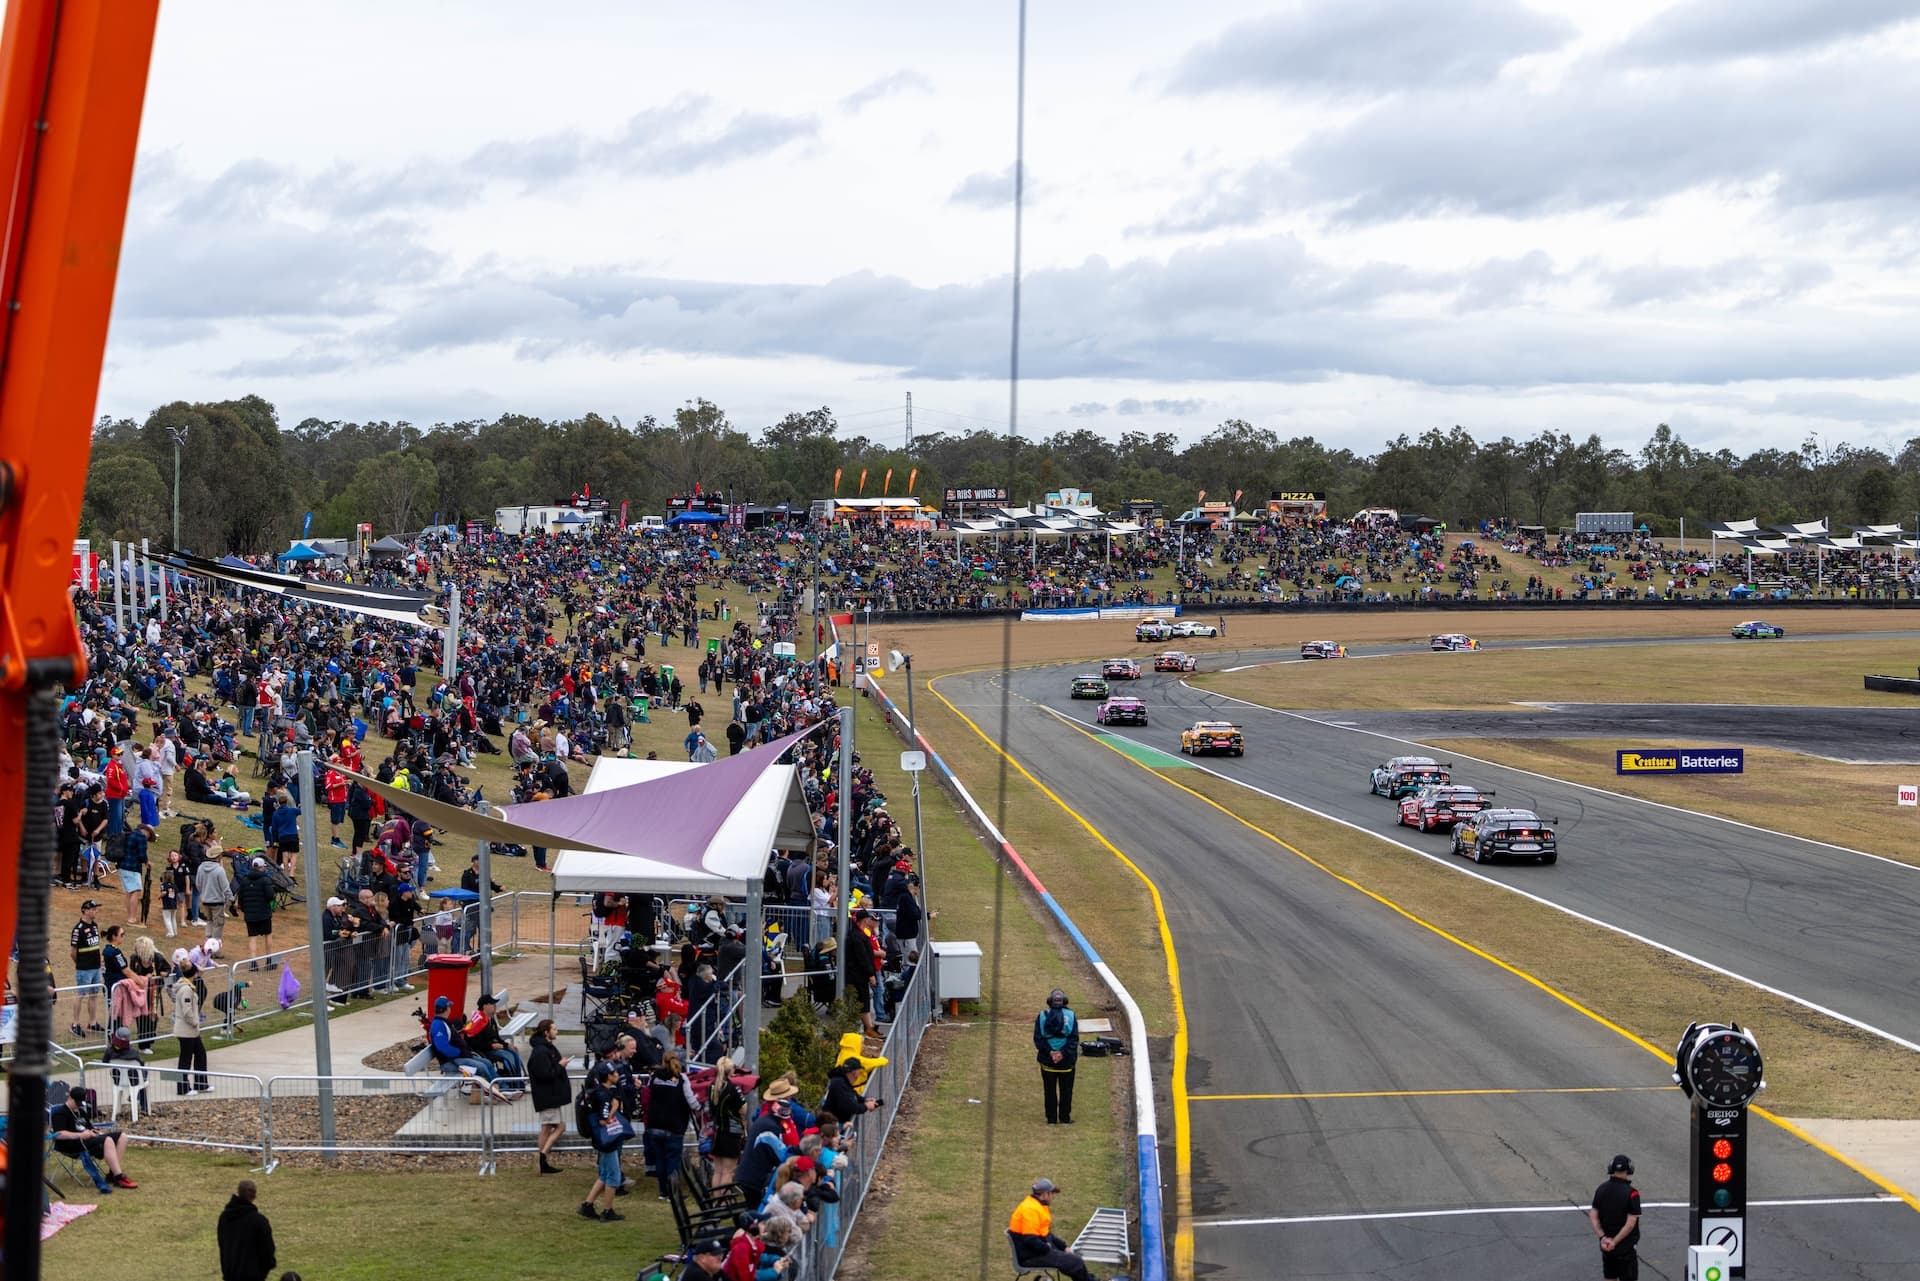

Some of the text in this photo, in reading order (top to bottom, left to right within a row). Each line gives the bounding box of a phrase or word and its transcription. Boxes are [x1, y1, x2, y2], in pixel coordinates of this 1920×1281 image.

[956, 489, 972, 499] RIBS
[975, 488, 996, 499] WINGS
[1280, 492, 1315, 500] PIZZA
[867, 658, 878, 666] SC
[1631, 754, 1738, 768] Century Batteries
[1900, 791, 1915, 801] 100
[1707, 1110, 1739, 1118] SEIKO
